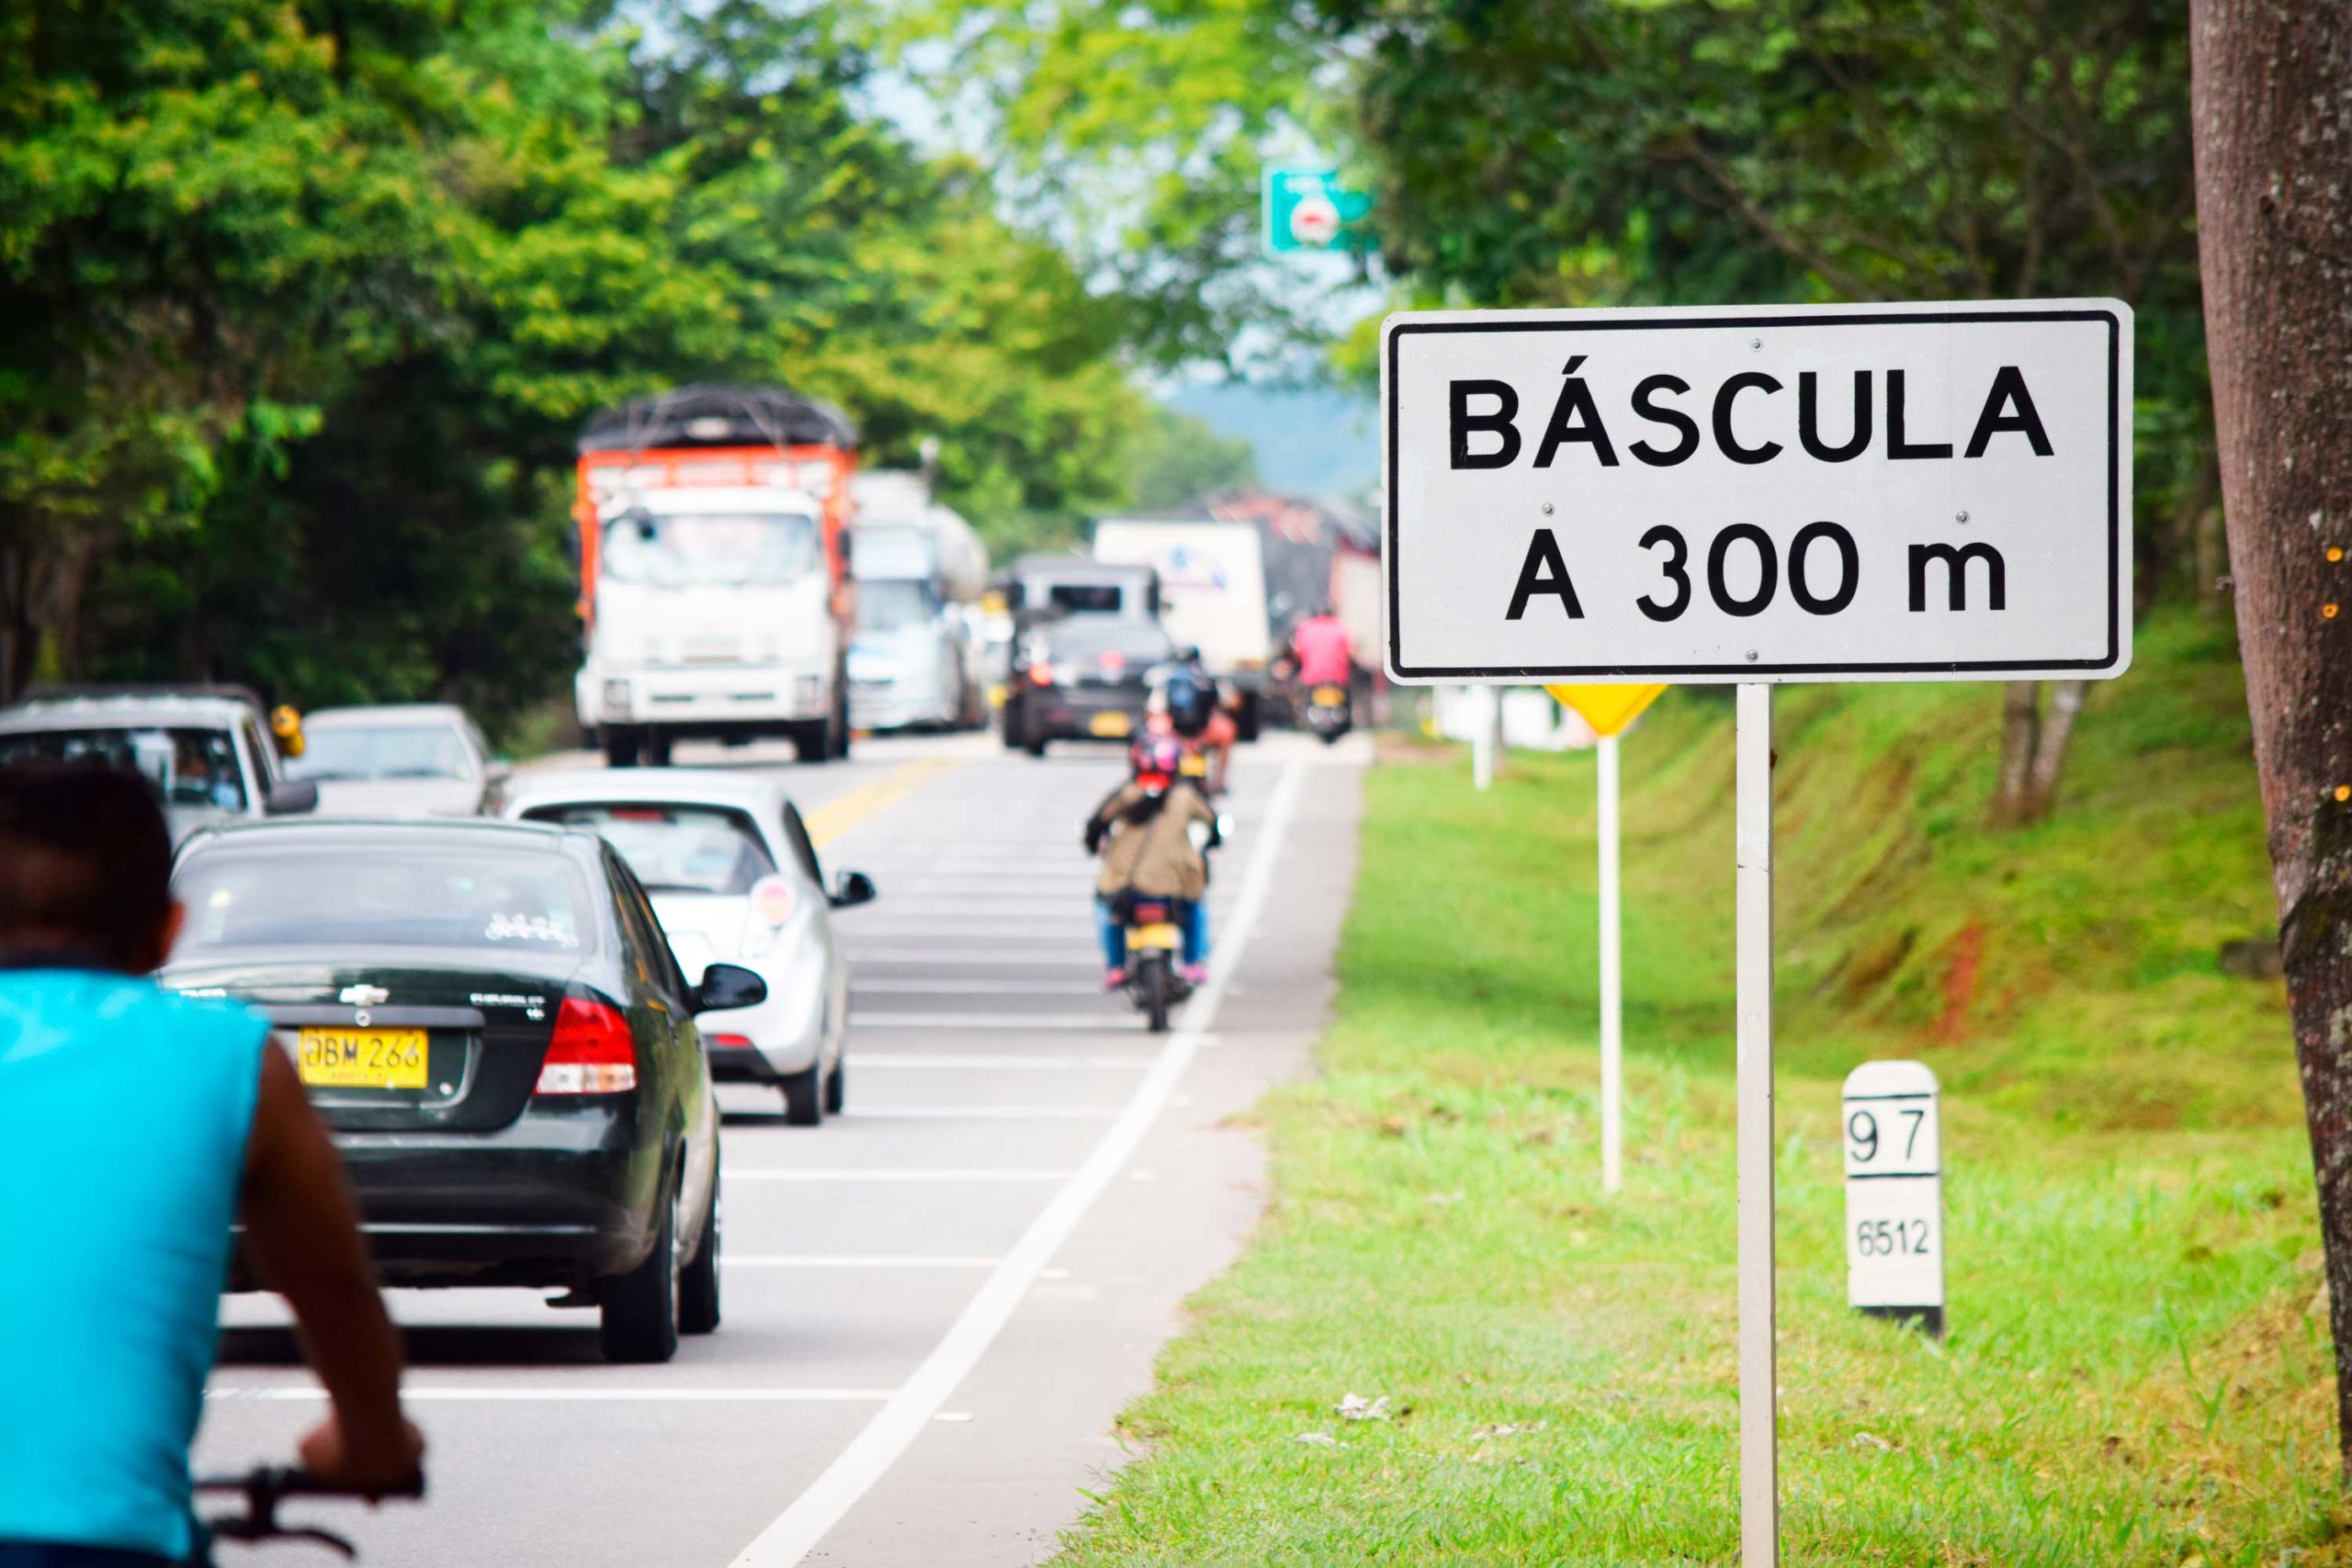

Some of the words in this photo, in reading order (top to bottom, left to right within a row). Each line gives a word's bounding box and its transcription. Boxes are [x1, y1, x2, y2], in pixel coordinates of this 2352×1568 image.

[1449, 355, 2054, 470] BÁSCULA
[1505, 528, 1585, 620] A
[1635, 521, 1860, 623] 300
[1907, 542, 2006, 613] m
[1857, 1218, 1928, 1257] 6512
